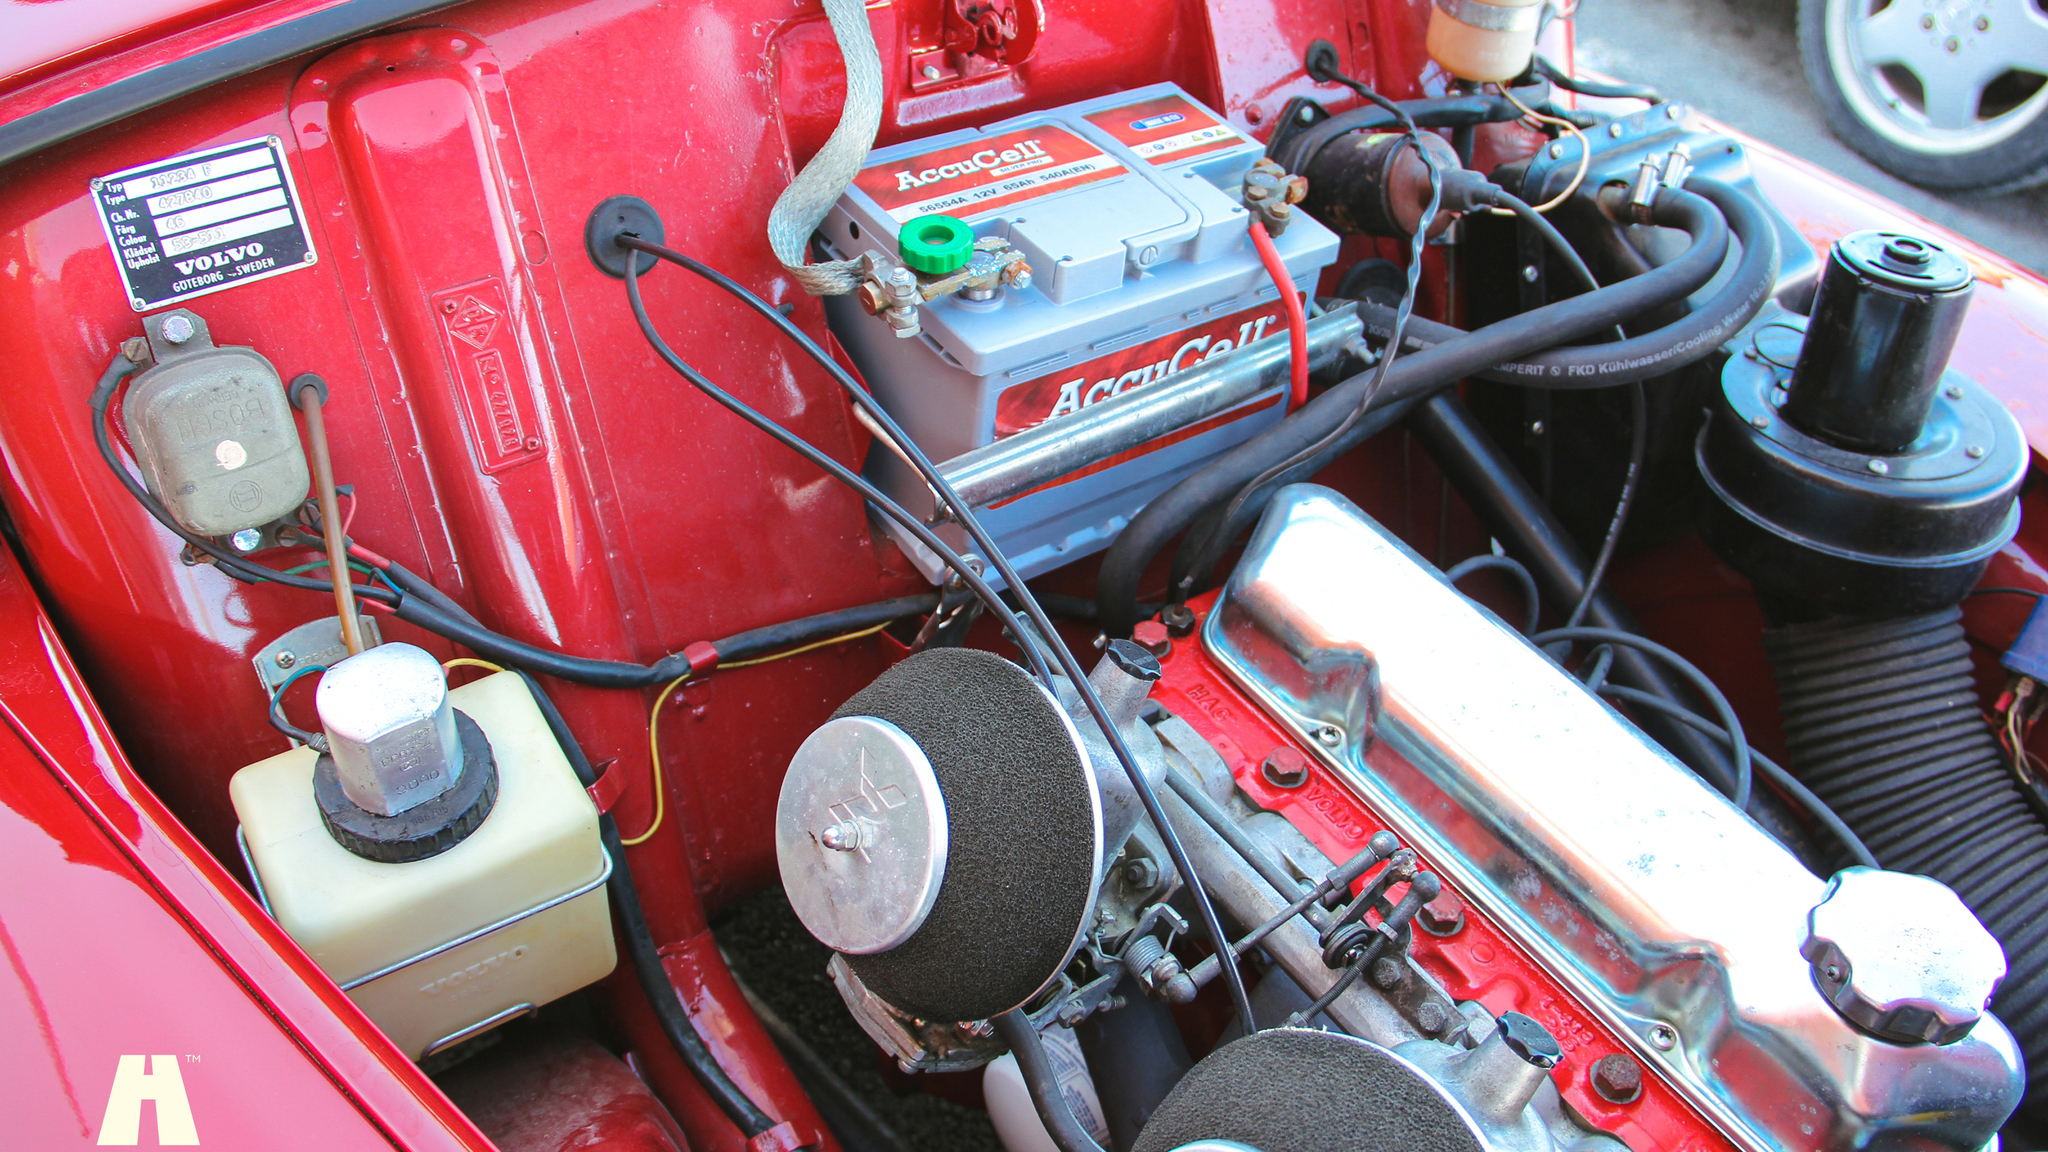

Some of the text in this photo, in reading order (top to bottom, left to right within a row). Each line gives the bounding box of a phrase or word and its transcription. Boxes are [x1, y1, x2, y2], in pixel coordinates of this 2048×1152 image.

[202, 163, 212, 177] F
[894, 140, 1047, 192] AccuCell
[999, 159, 1042, 173] SILVER PRO
[104, 182, 123, 194] Typ
[919, 163, 1096, 213] 56554A 12V 65Ah 540A(EN)
[103, 194, 126, 206] Type
[115, 224, 137, 236] Färg
[166, 215, 186, 231] 46
[119, 234, 148, 247] Colour
[122, 242, 157, 259] Klädsel
[173, 242, 264, 276] VOLVO
[126, 253, 161, 270] Upholst
[235, 257, 275, 276] SWEDEN
[1493, 362, 1545, 377] MPERIT
[1568, 364, 1596, 376] FKD
[1598, 324, 1723, 374] Kühlwasser/Cooling
[1721, 300, 1750, 328] Water
[1305, 786, 1364, 840] VOLVO
